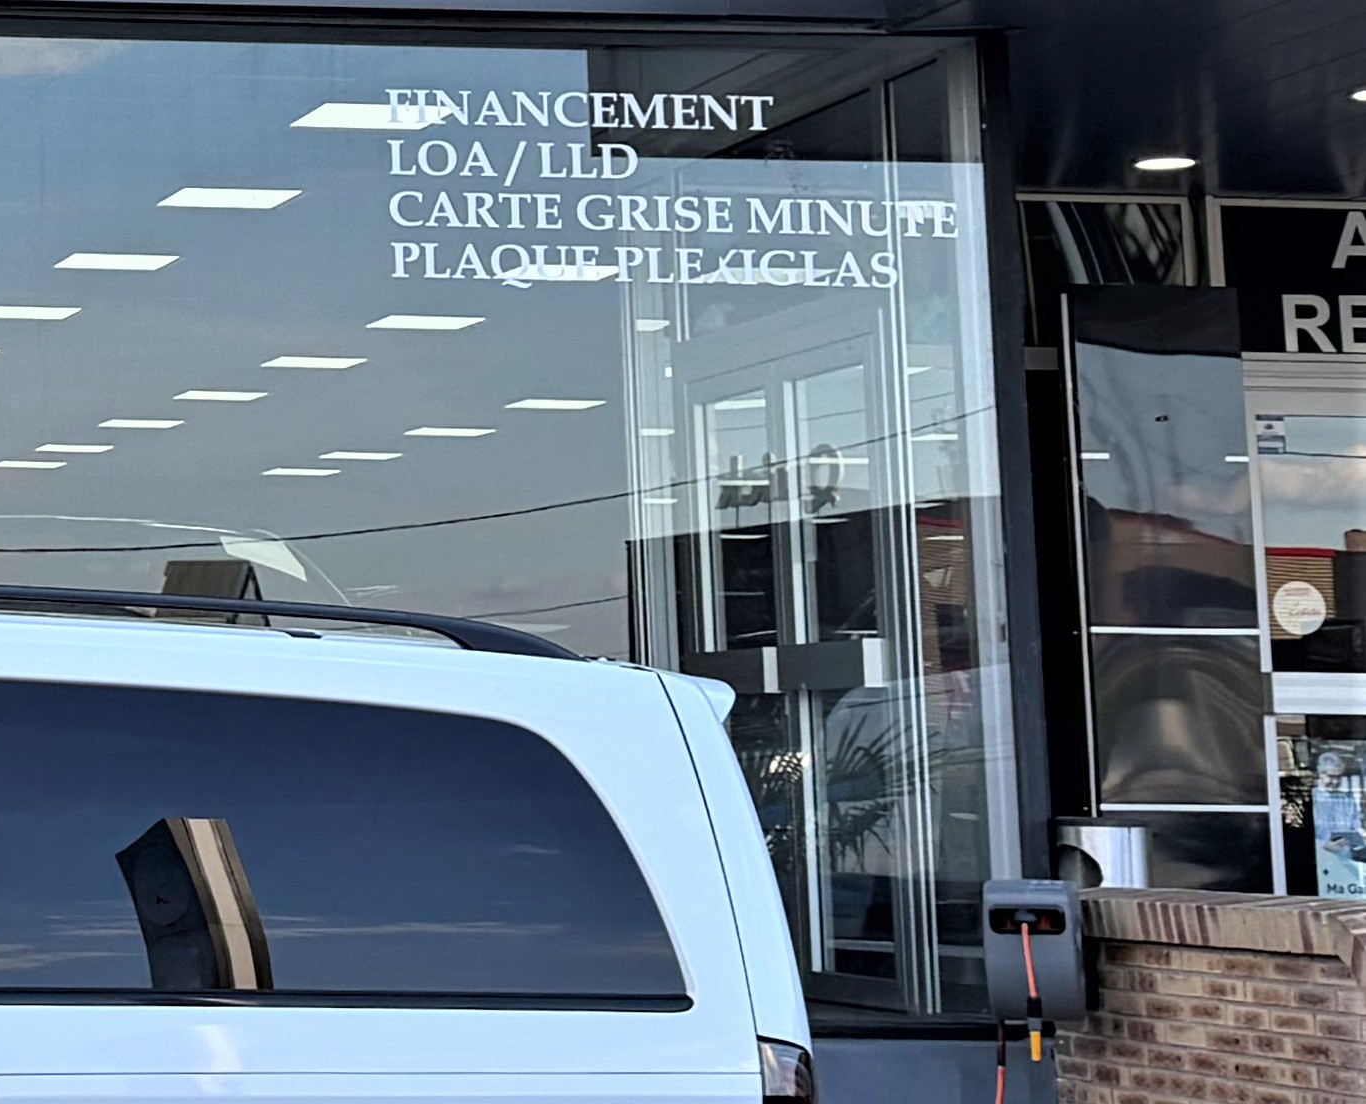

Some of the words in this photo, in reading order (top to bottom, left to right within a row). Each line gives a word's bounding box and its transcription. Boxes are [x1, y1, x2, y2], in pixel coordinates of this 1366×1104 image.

[385, 88, 774, 131] FINANCEMENT
[389, 190, 562, 229] CARTE
[576, 194, 733, 233] GRISE
[746, 197, 959, 239] MINUTE
[391, 241, 600, 289] PLAQUE
[614, 246, 898, 288] PLEXIGLAS
[1281, 293, 1366, 353] RE
